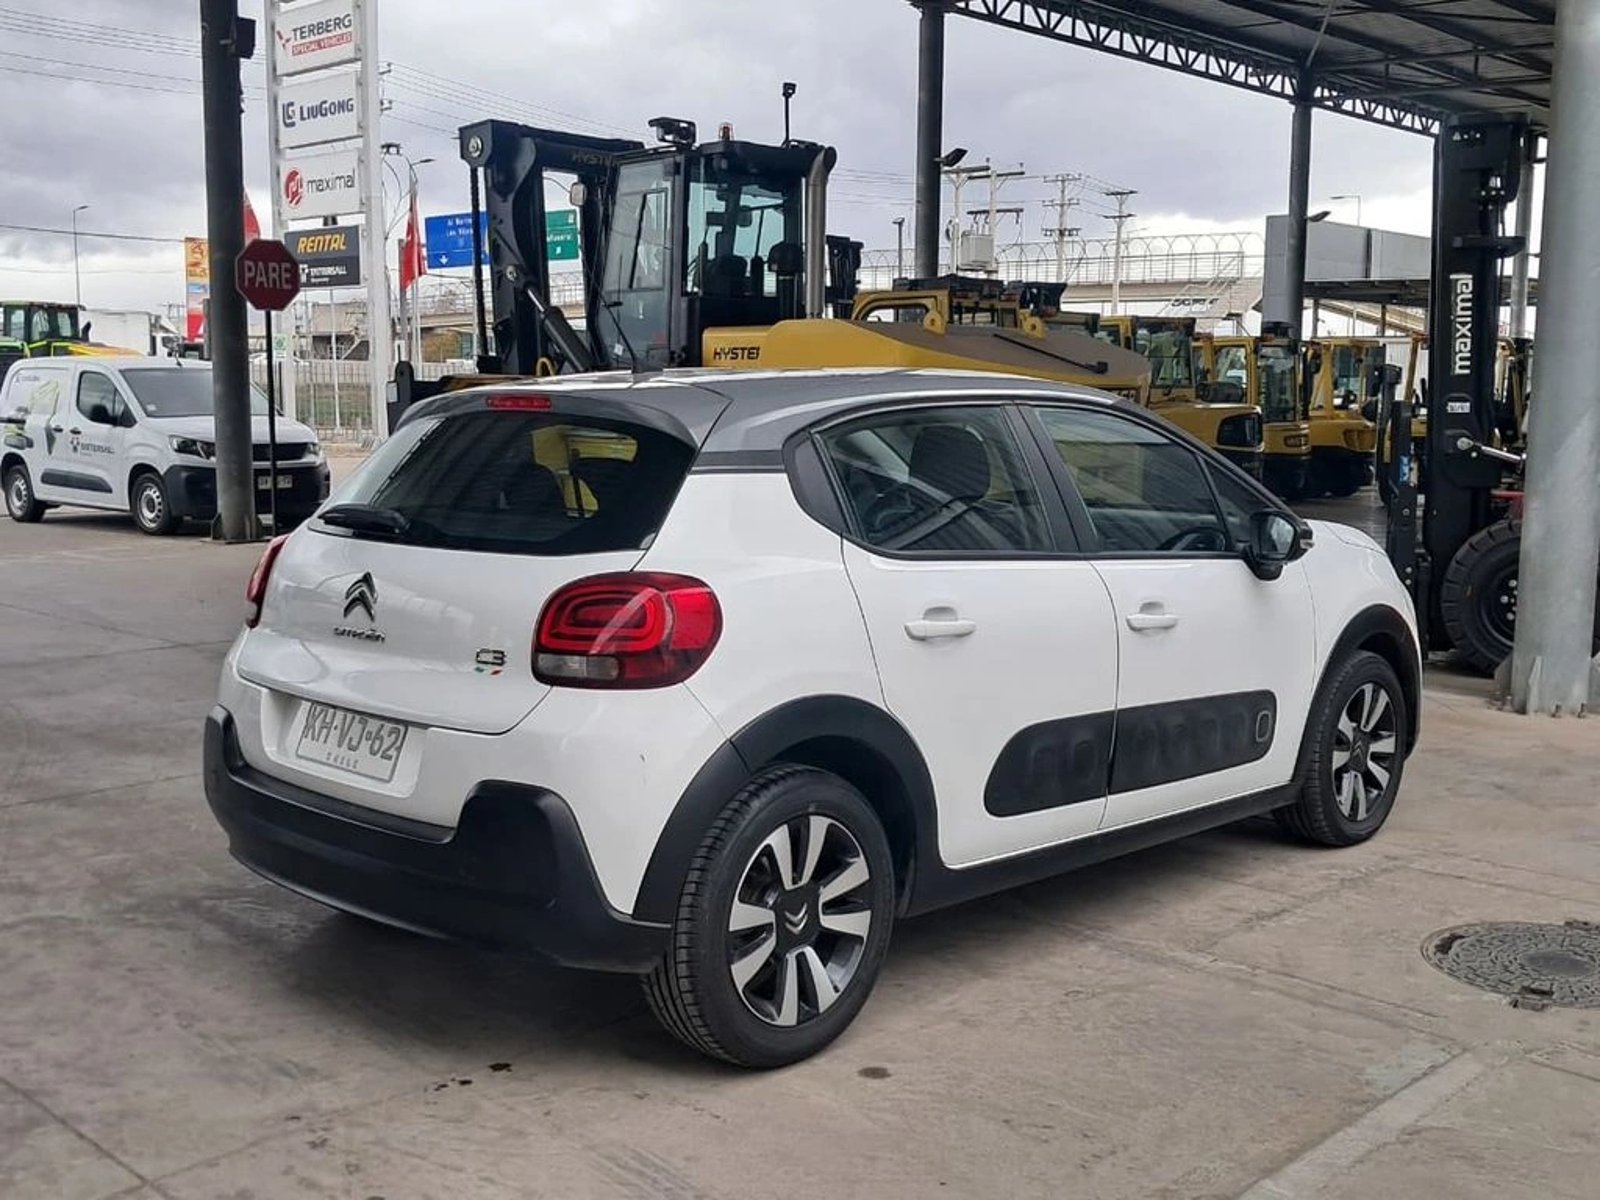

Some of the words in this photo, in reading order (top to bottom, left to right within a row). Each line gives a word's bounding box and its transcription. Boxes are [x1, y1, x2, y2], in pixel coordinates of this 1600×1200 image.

[292, 14, 352, 41] TERBERG
[307, 168, 355, 195] maximal
[297, 233, 347, 254] RENTAL
[244, 260, 291, 289] PARE
[1450, 273, 1473, 375] maximal
[475, 649, 506, 666] C3
